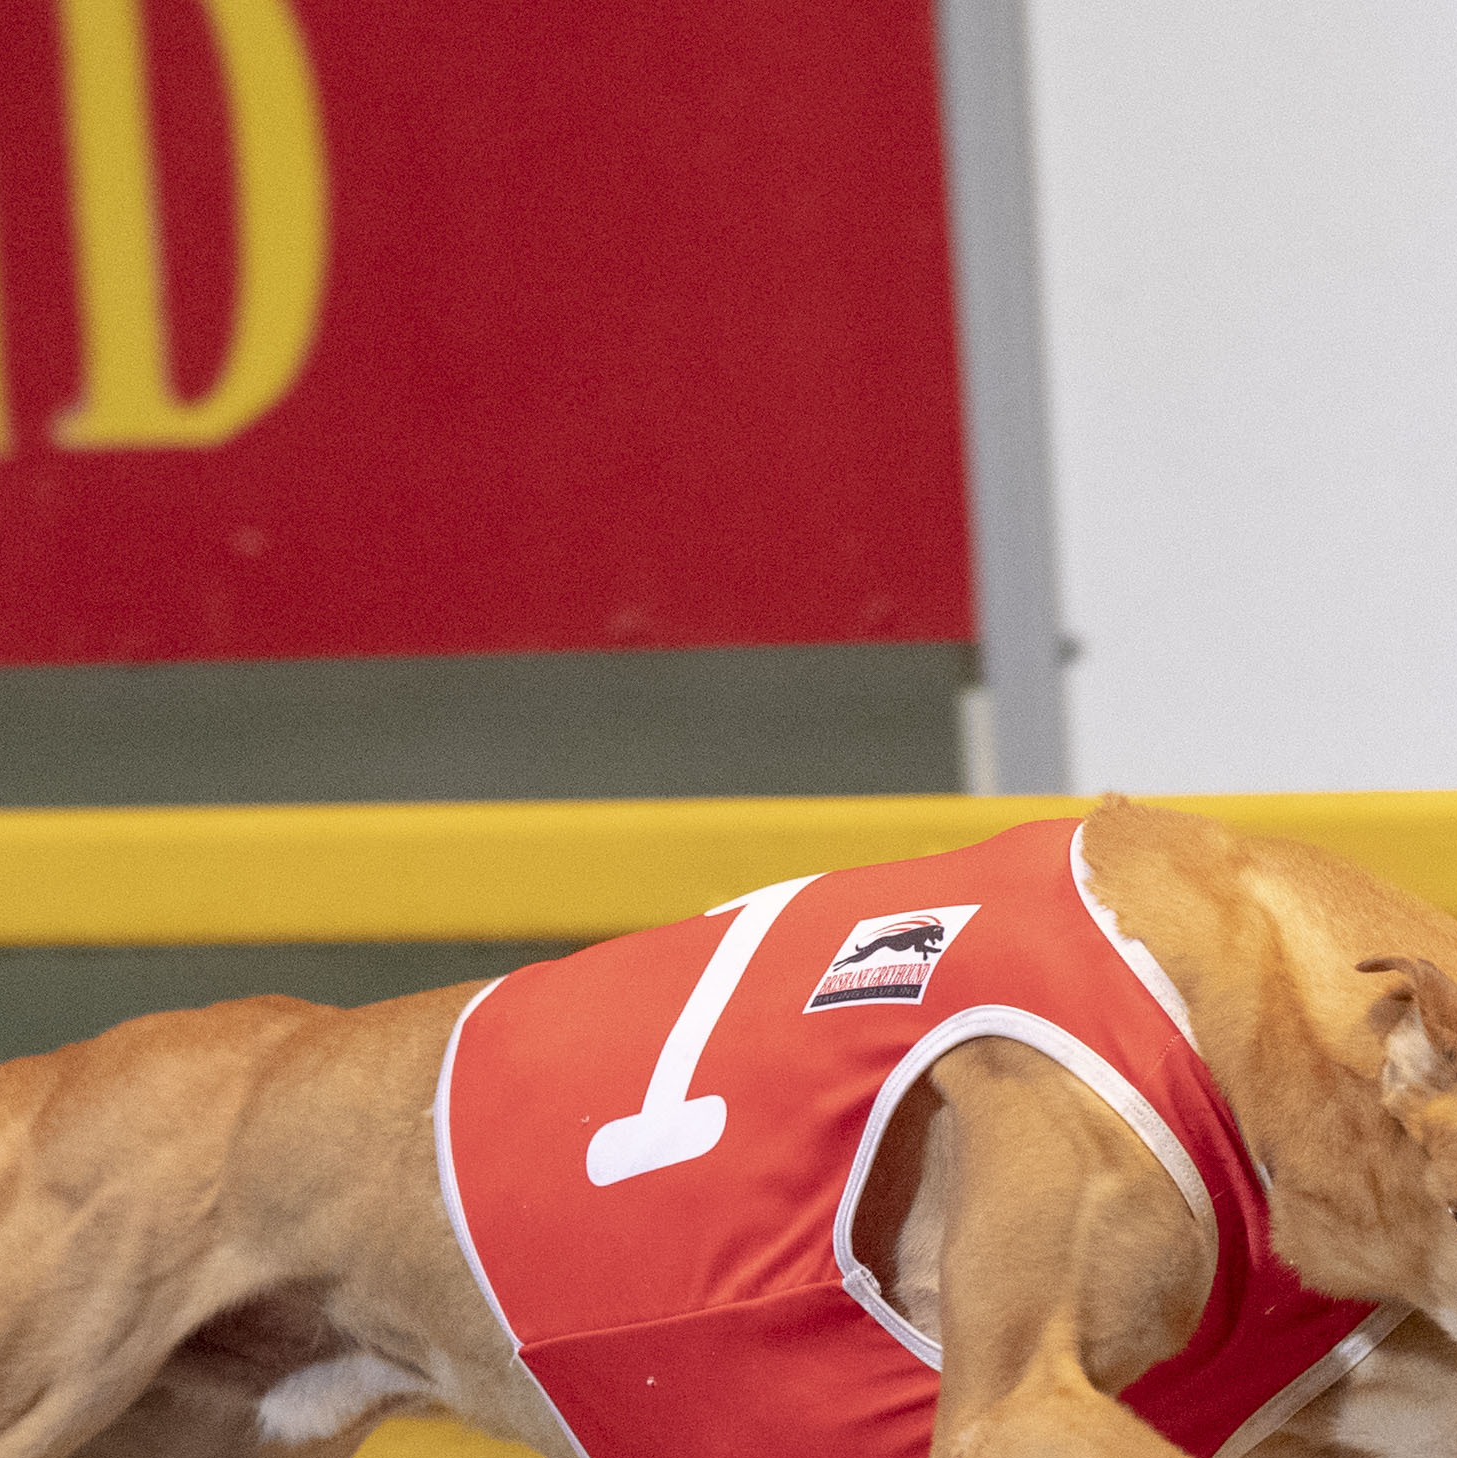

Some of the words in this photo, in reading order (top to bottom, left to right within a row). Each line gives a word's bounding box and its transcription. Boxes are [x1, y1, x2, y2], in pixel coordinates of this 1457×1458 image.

[813, 989, 861, 1005] RACING
[864, 986, 896, 997] CLUB
[818, 968, 874, 996] BRISBANE
[867, 963, 931, 988] GREYHOUND
[586, 871, 831, 1187] 1
